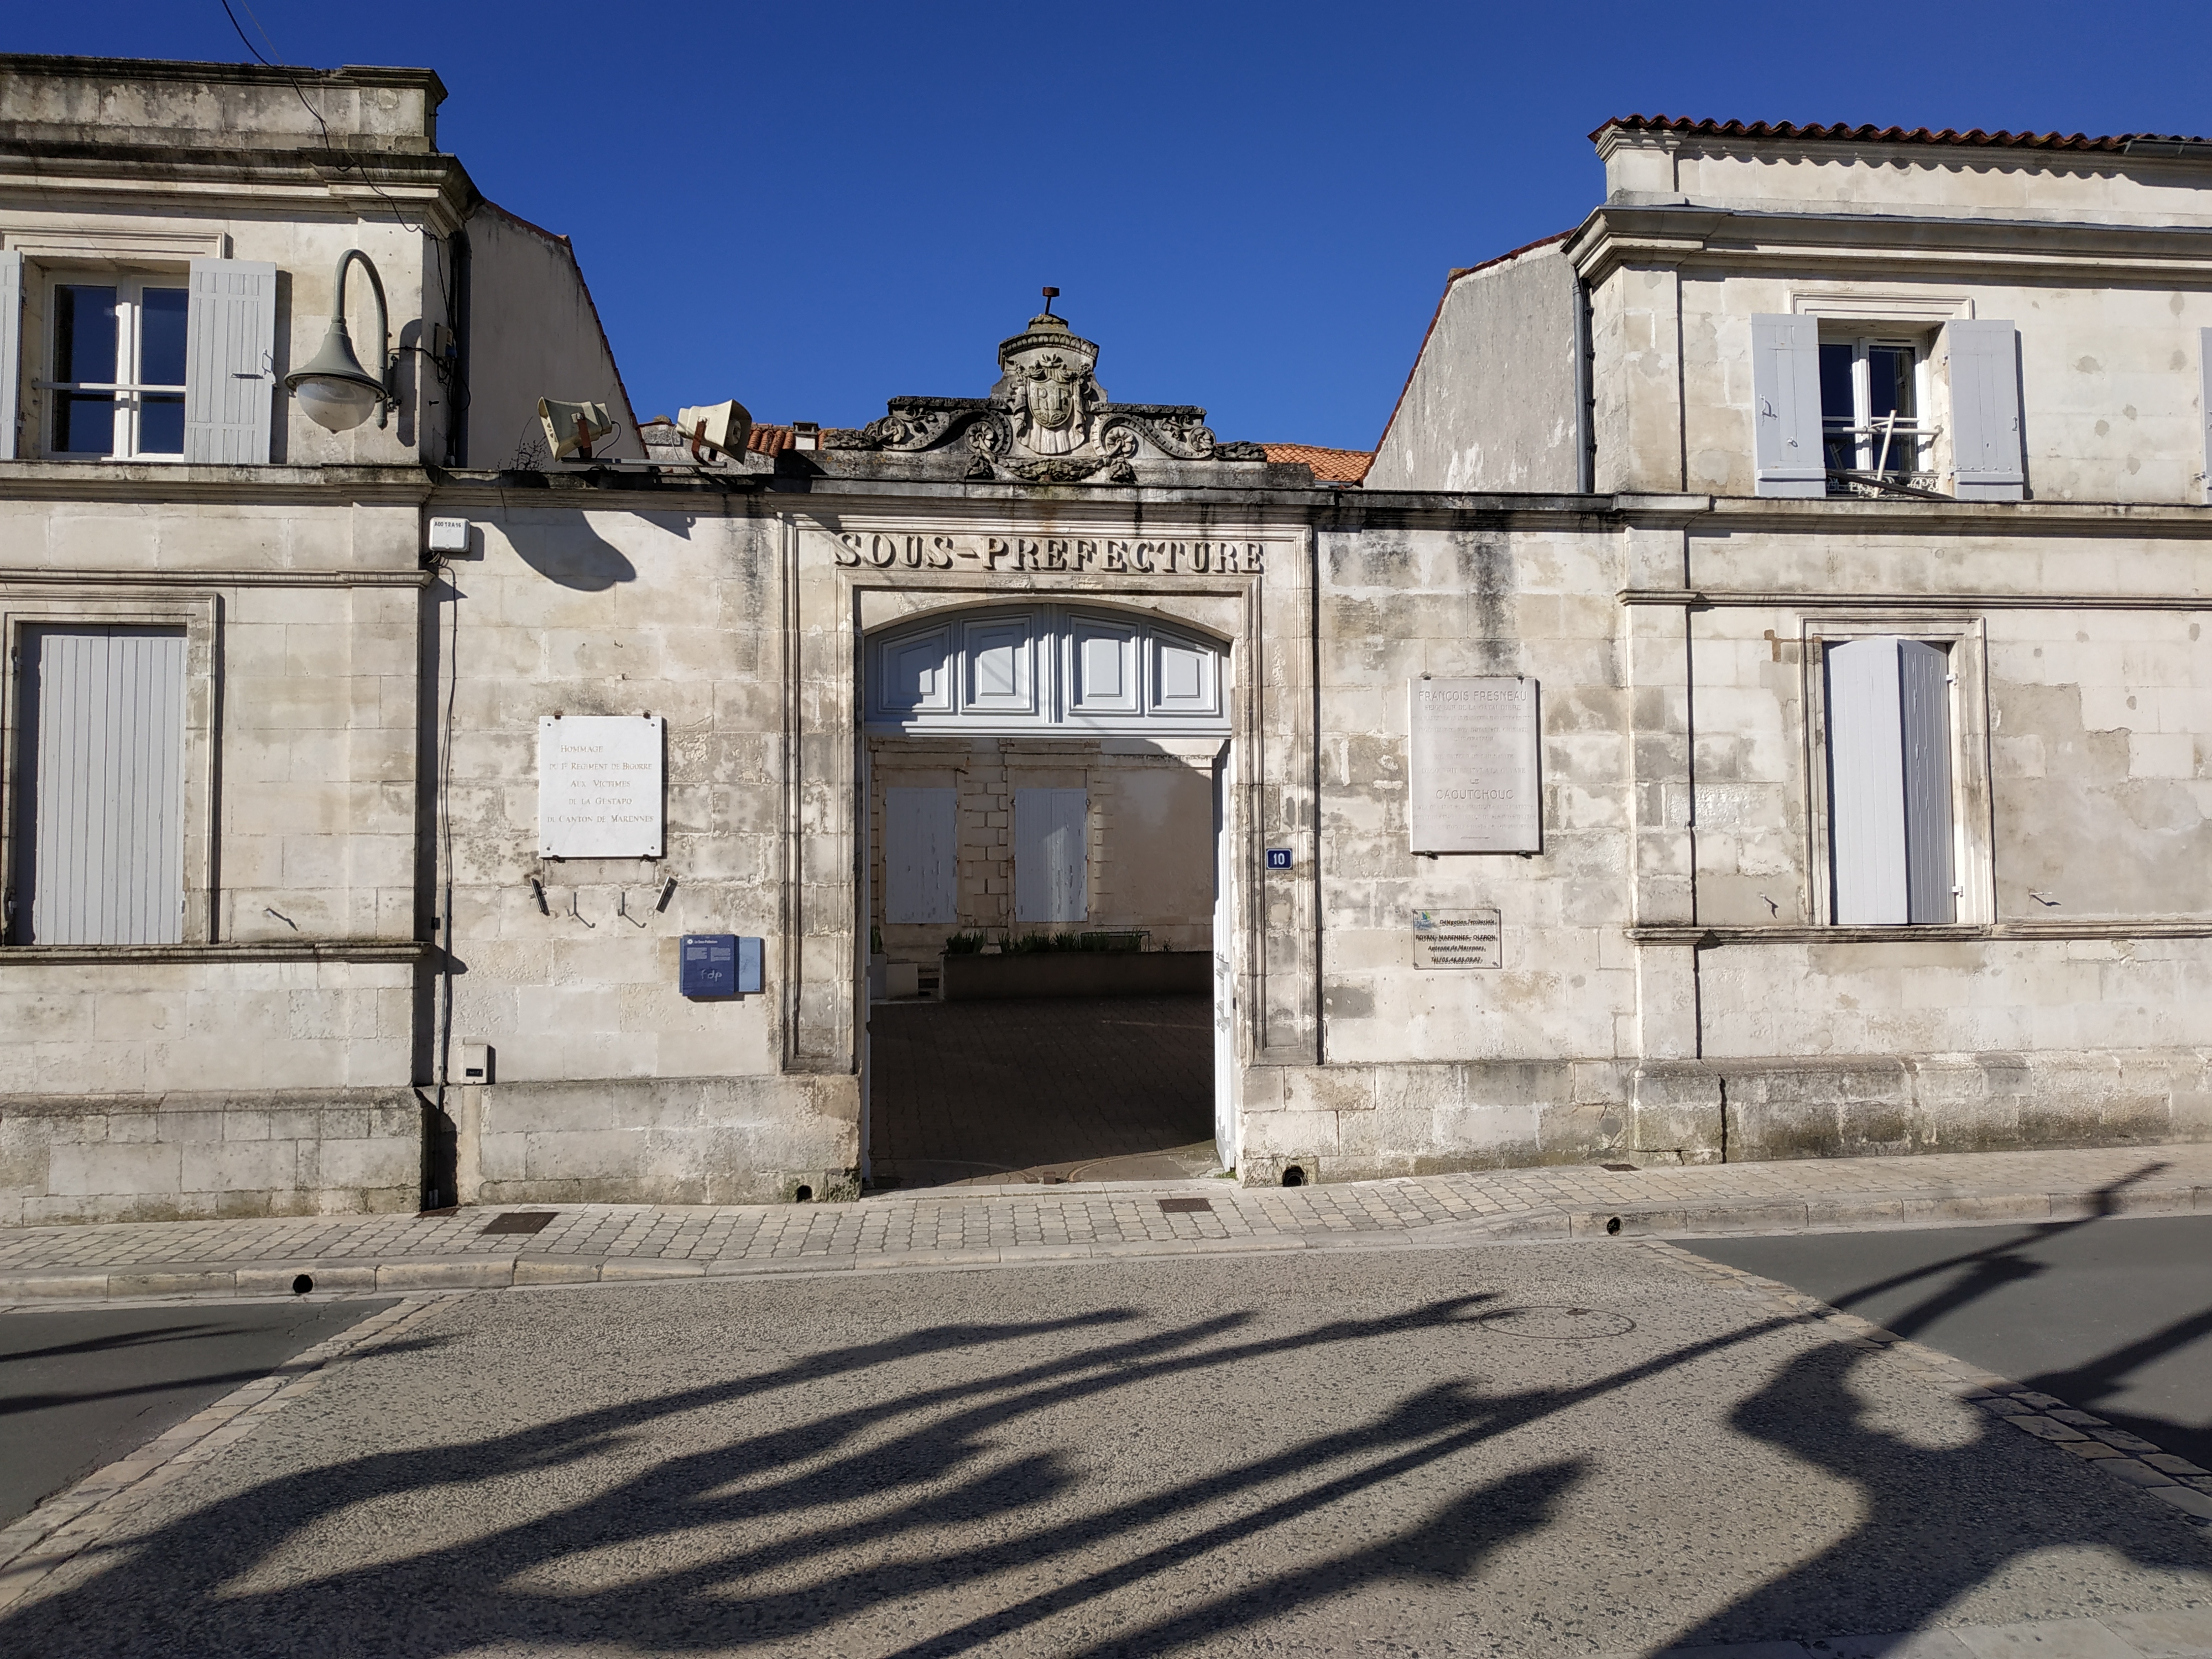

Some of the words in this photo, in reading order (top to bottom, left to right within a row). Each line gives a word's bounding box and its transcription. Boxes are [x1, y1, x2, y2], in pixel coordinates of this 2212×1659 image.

[834, 533, 1264, 574] SOUS-PREFECTURE
[1418, 691, 1469, 702] FRANÇOIS
[1474, 691, 1526, 701] FRESNEAU
[1436, 789, 1514, 800] CAOUTCHOUC
[1274, 853, 1285, 864] 10
